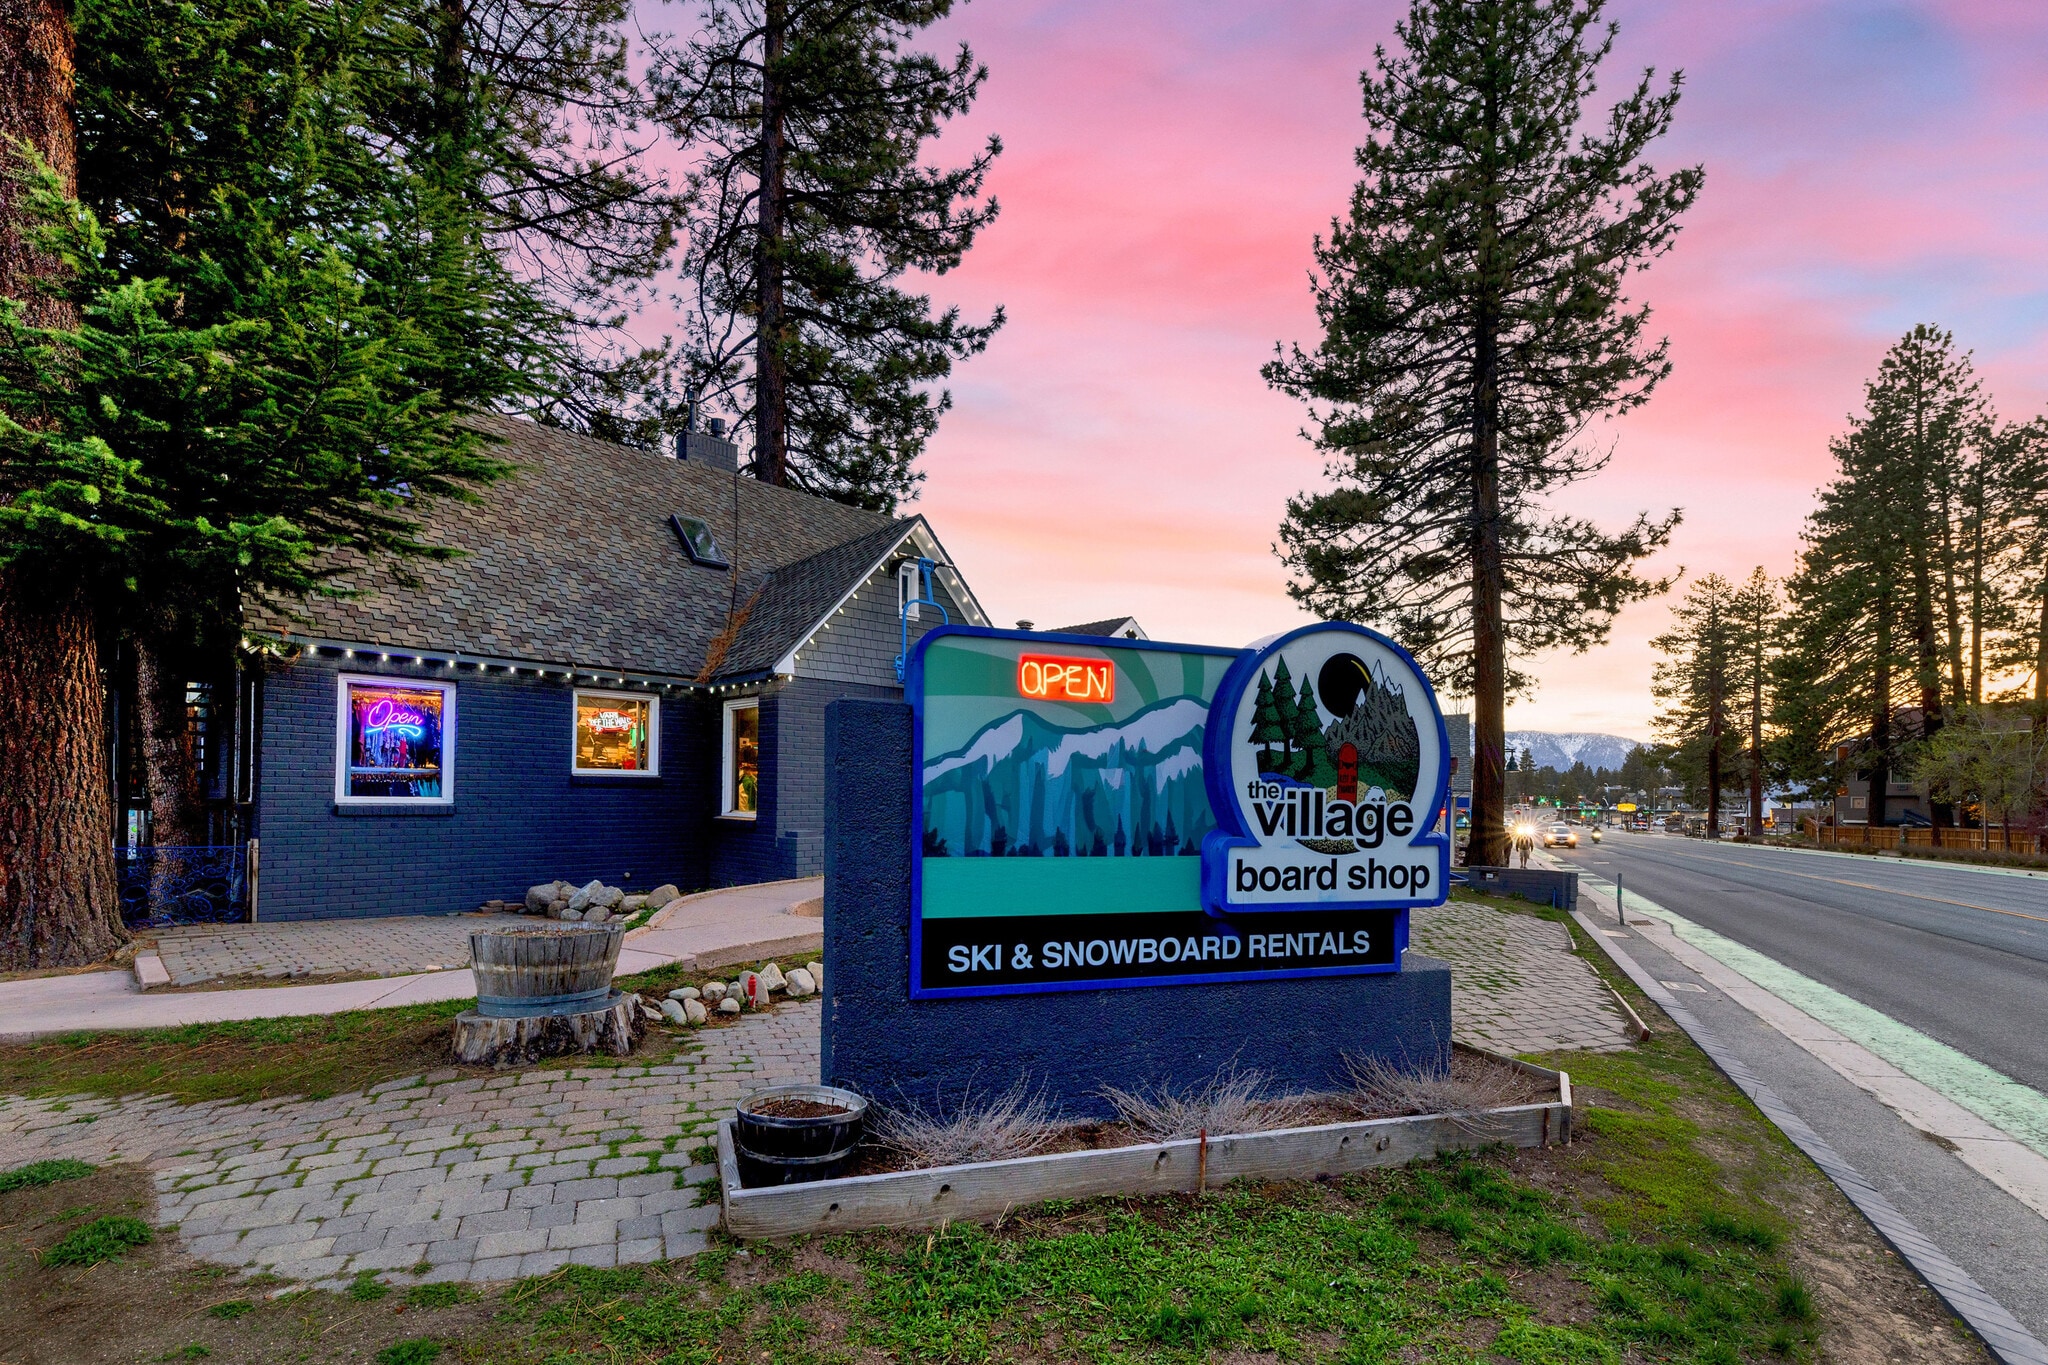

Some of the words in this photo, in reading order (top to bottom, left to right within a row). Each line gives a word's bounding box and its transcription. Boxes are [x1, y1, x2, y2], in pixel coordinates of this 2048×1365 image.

[1021, 661, 1107, 698] OPEN
[368, 699, 423, 732] Open
[602, 718, 615, 727] THE
[1247, 780, 1280, 799] the
[1252, 790, 1414, 849] village
[1236, 858, 1338, 892] board
[1347, 857, 1430, 897] shop
[948, 944, 1002, 973] SKI
[1011, 943, 1034, 970] &
[1042, 935, 1242, 968] SNOWBOARD
[1248, 930, 1371, 958] RENTALS
